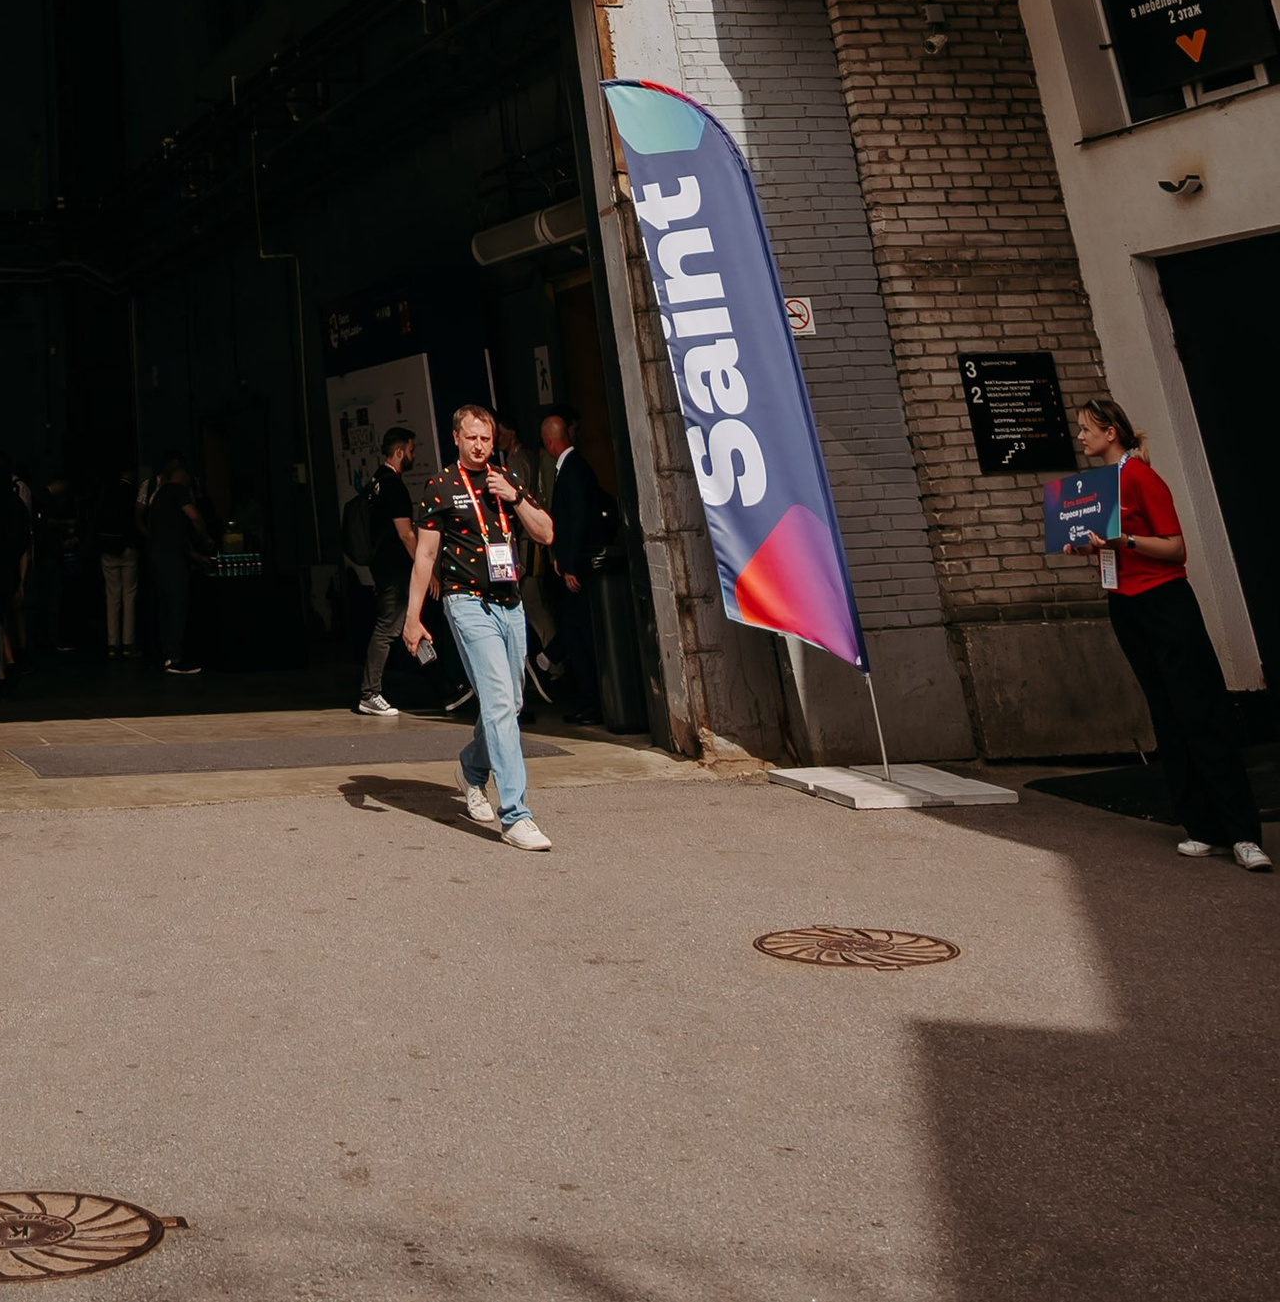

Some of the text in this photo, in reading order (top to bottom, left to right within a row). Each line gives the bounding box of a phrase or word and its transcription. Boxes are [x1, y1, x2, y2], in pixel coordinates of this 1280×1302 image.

[1130, 8, 1137, 18] в
[1168, 3, 1202, 24] 2 этаж
[631, 175, 767, 507] Saint
[965, 361, 977, 378] 3
[971, 386, 984, 403] 2
[1014, 442, 1026, 450] 2 3
